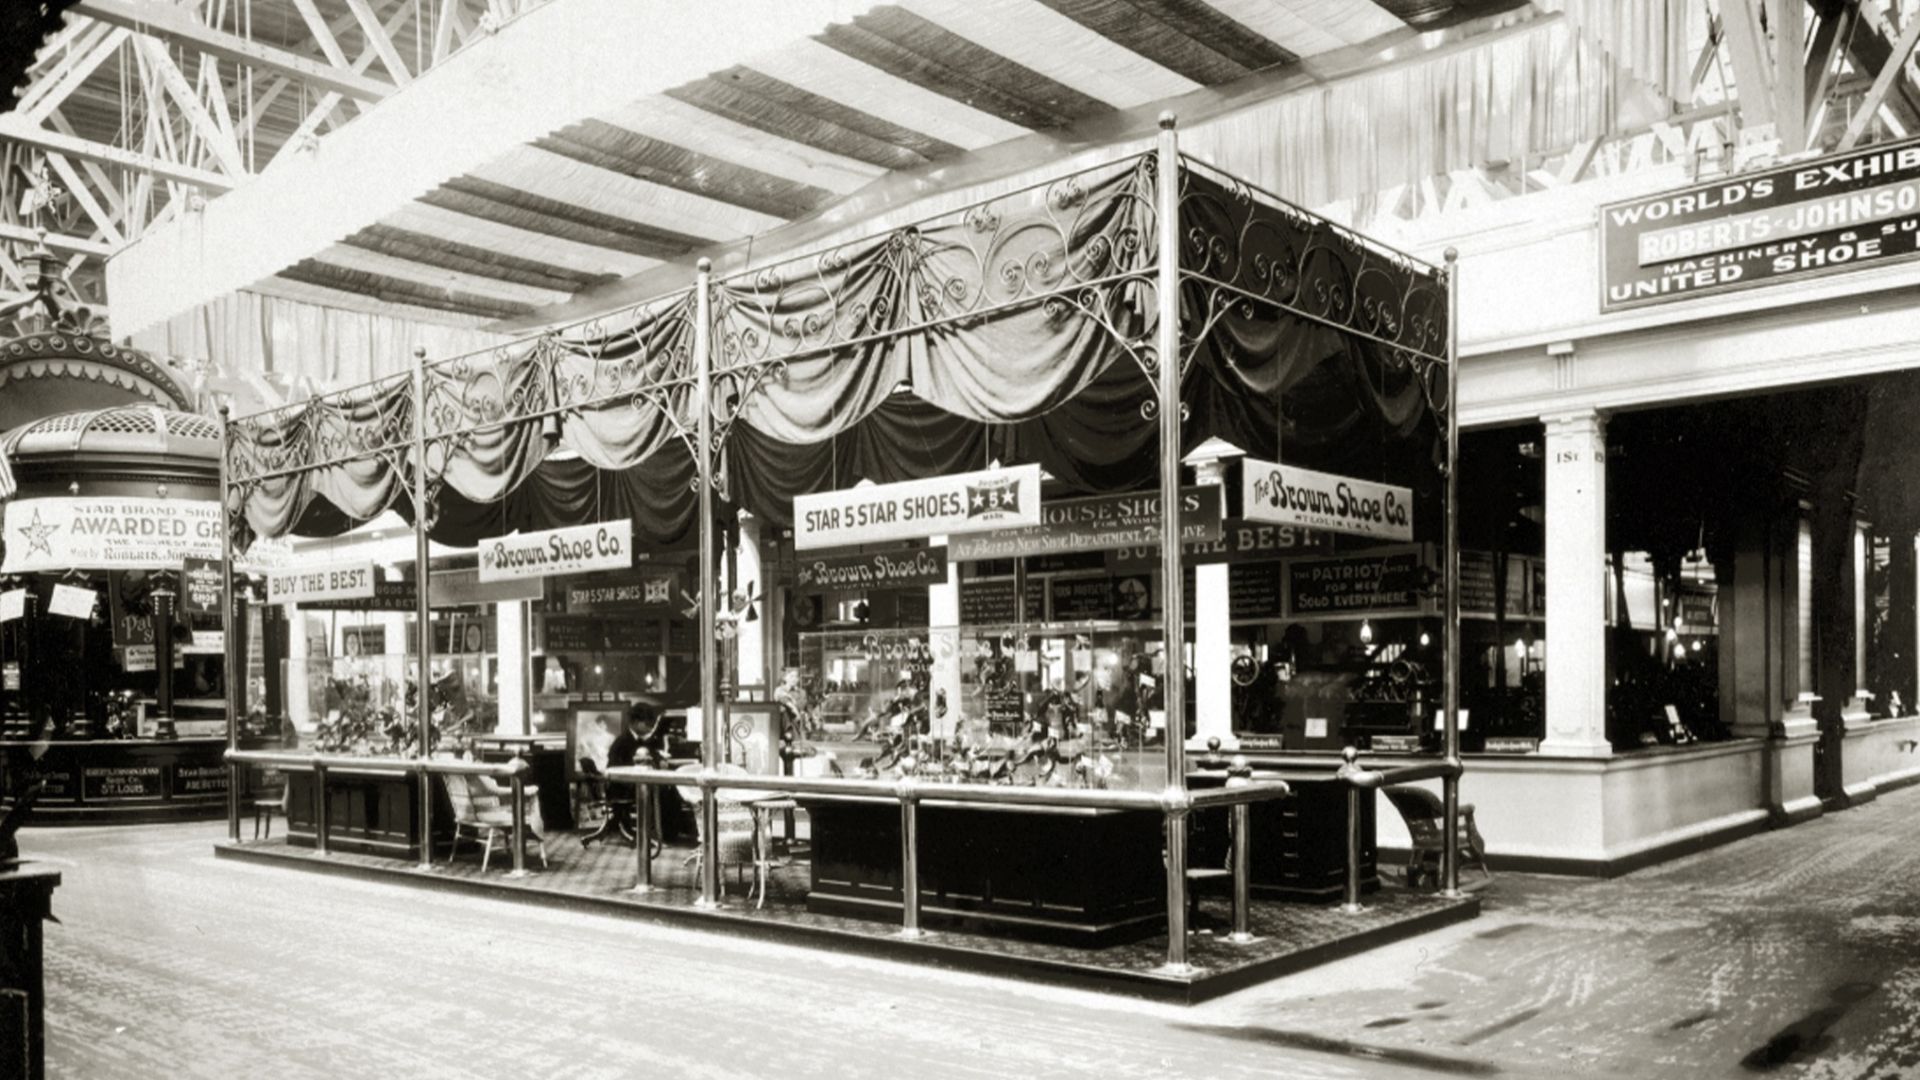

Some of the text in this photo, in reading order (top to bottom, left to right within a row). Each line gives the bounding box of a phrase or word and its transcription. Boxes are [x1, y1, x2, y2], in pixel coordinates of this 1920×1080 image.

[1611, 149, 1920, 227] WORLD'S EXHIB
[1610, 265, 1743, 300] UNITED
[1773, 238, 1881, 272] SHOE
[1664, 238, 1818, 274] MACHINERY
[73, 505, 115, 515] STAR
[122, 505, 177, 516] BRAND
[805, 491, 999, 532] STAR 5 STAR SHOES. 5
[1117, 494, 1200, 518] SHOS
[1254, 471, 1409, 526] The Brown Shoe Co.
[71, 517, 187, 537] AWARDED
[494, 542, 548, 568] Brown
[549, 535, 593, 562] Shoe
[597, 528, 624, 557] Co.
[273, 569, 367, 594] BUY THE BEST.
[814, 561, 873, 584] Brown
[874, 555, 917, 579] Shoe
[1313, 564, 1381, 580] PATRIOT
[1334, 591, 1408, 606] EVERYWHERE
